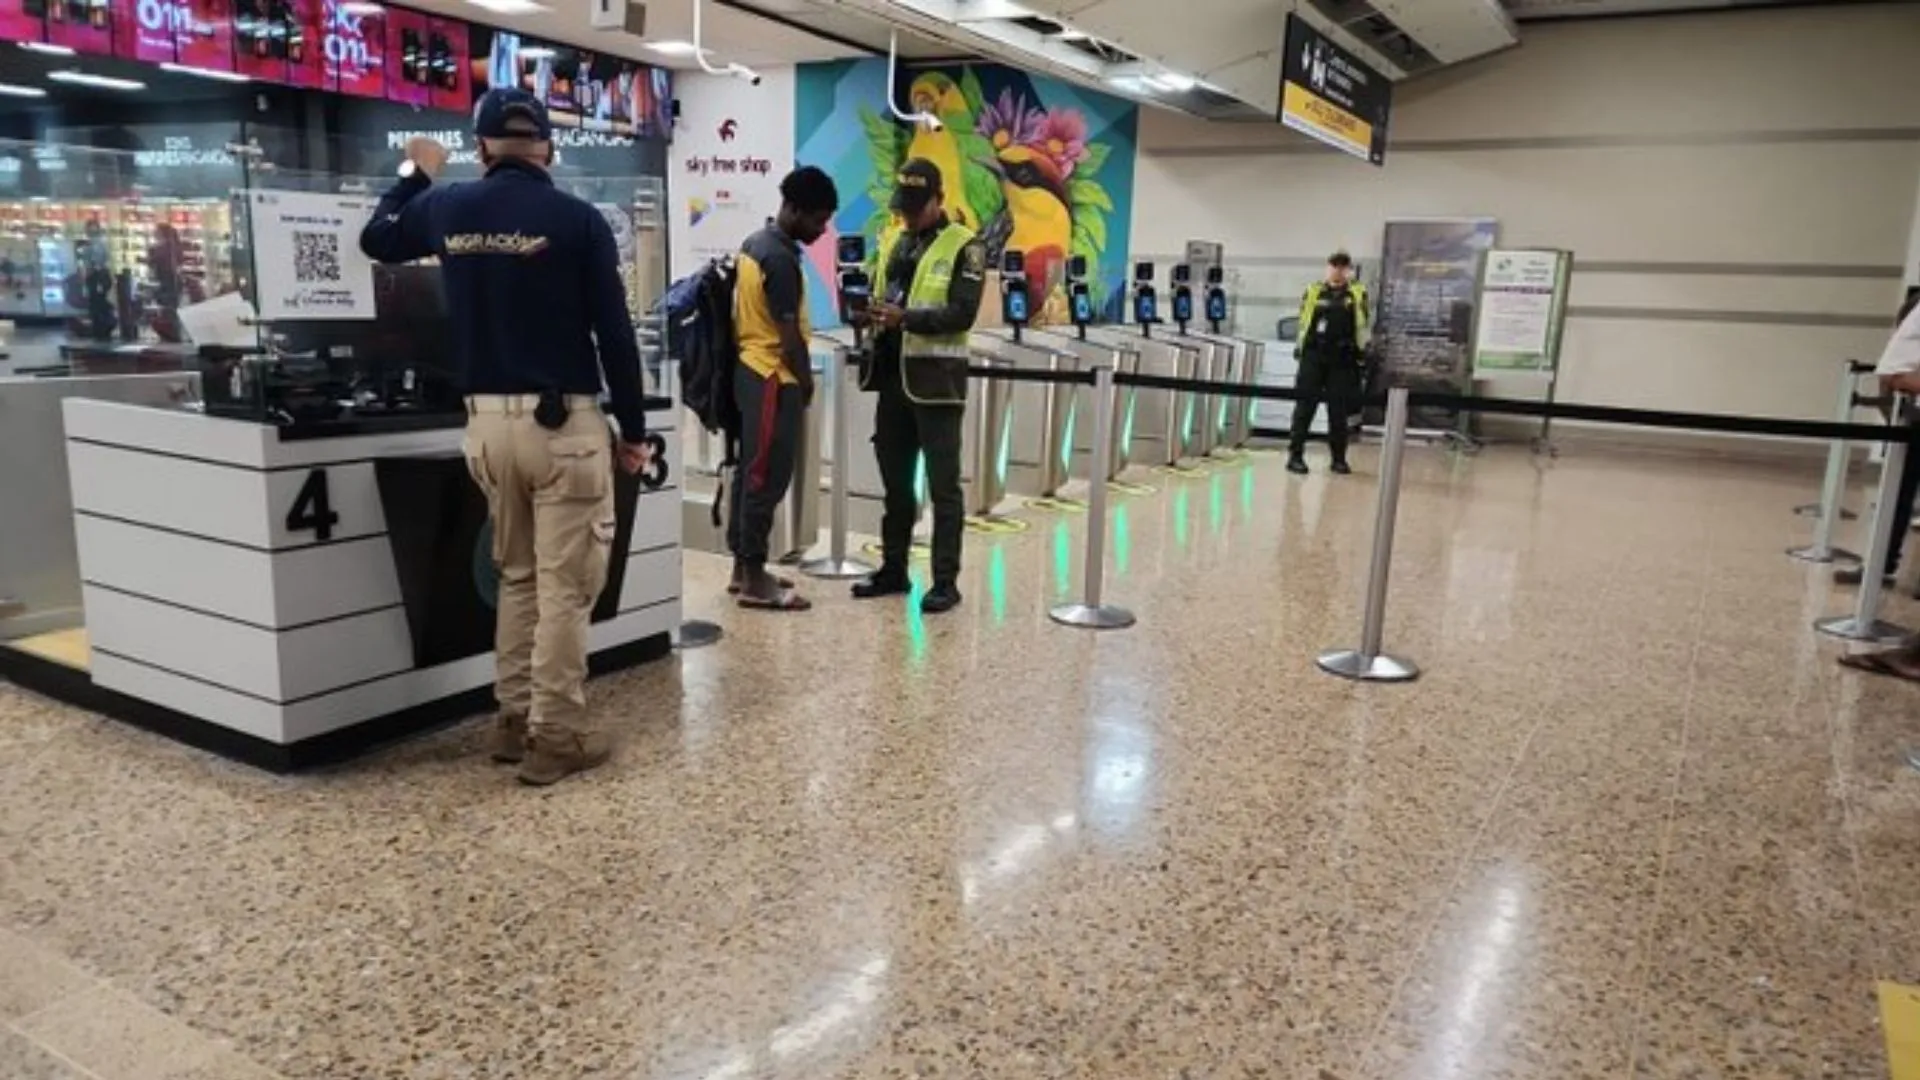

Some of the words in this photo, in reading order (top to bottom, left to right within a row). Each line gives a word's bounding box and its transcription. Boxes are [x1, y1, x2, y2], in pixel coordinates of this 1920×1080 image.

[686, 156, 708, 177] sky
[712, 155, 736, 172] free
[740, 155, 771, 177] shop
[641, 433, 668, 490] 3
[286, 467, 339, 541] 4
